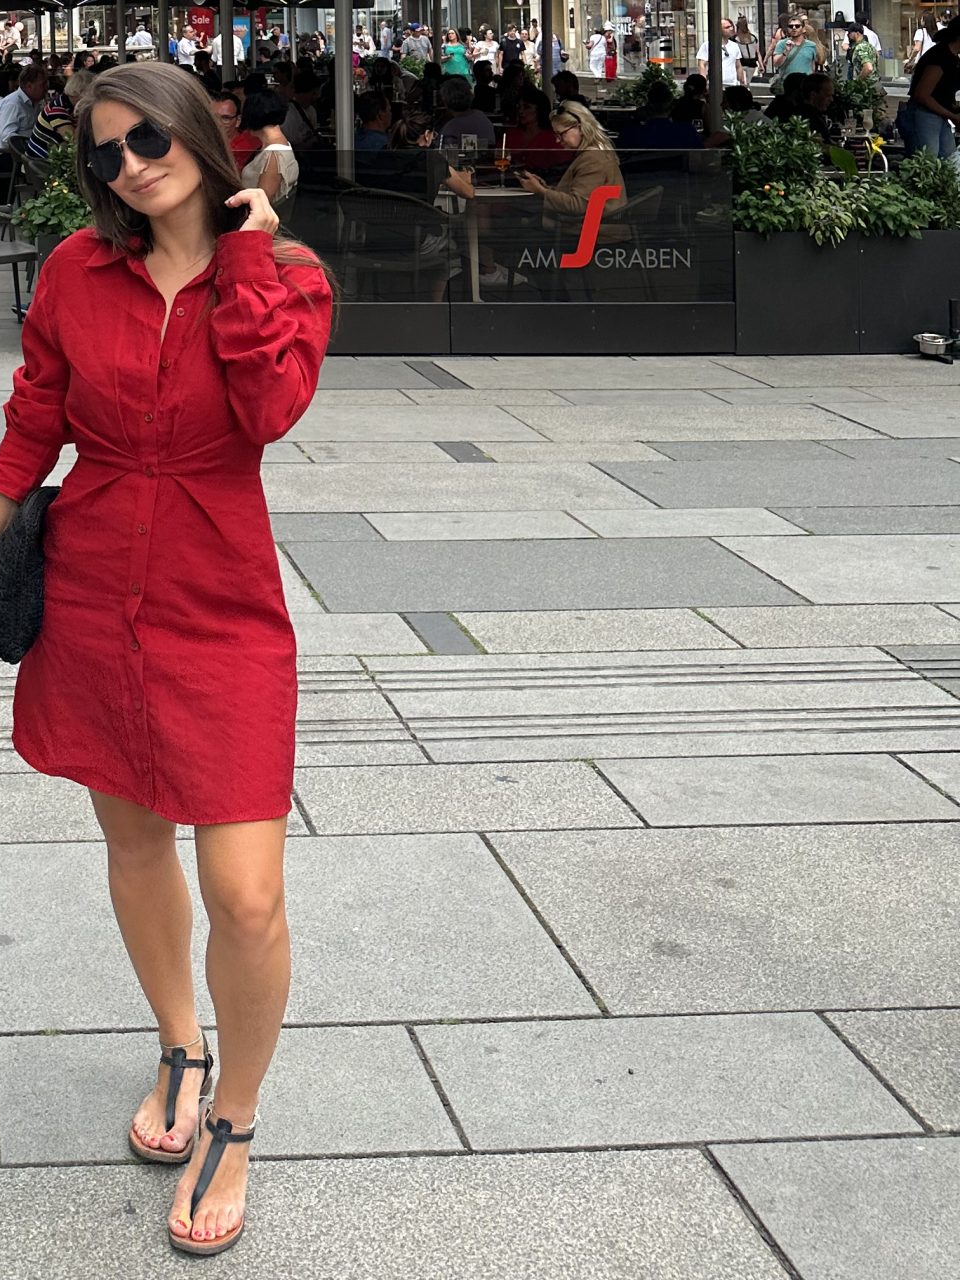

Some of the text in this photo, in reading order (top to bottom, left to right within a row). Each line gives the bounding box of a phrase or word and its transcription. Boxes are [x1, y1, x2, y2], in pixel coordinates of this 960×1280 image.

[191, 14, 210, 25] Sale
[616, 23, 632, 36] SALE
[518, 248, 558, 269] AM
[595, 248, 691, 269] GRABEN
